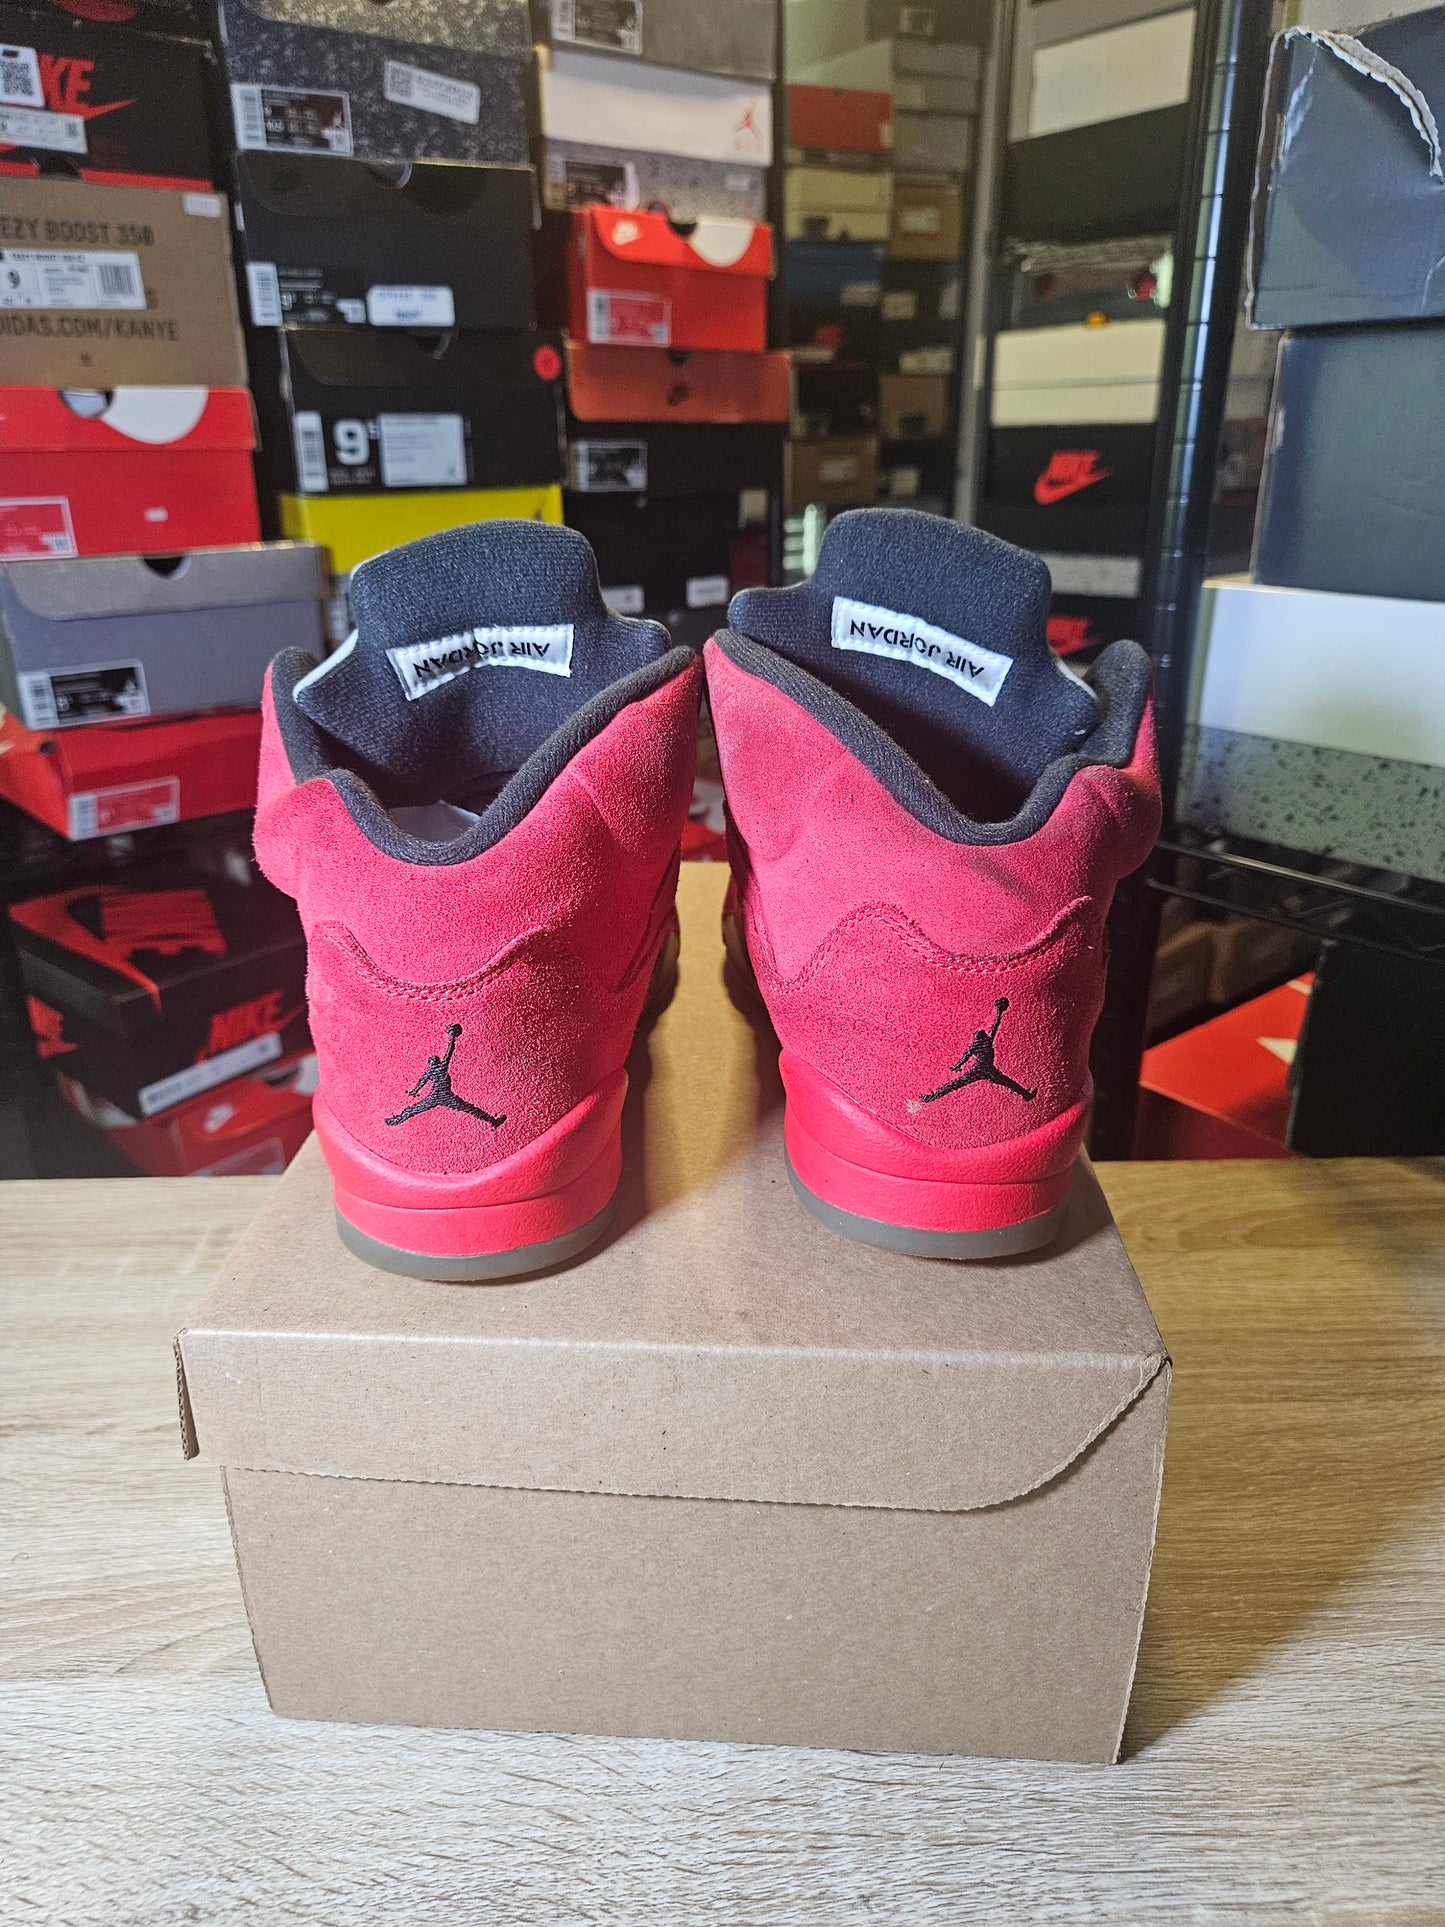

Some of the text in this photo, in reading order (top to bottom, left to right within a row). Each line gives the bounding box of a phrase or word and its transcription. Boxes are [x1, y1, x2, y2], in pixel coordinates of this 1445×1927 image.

[37, 52, 94, 115] KE
[44, 218, 110, 244] BOOST
[117, 223, 155, 247] 350
[412, 640, 550, 678] AIR JORDAN
[850, 619, 985, 678] AIR JORDAN
